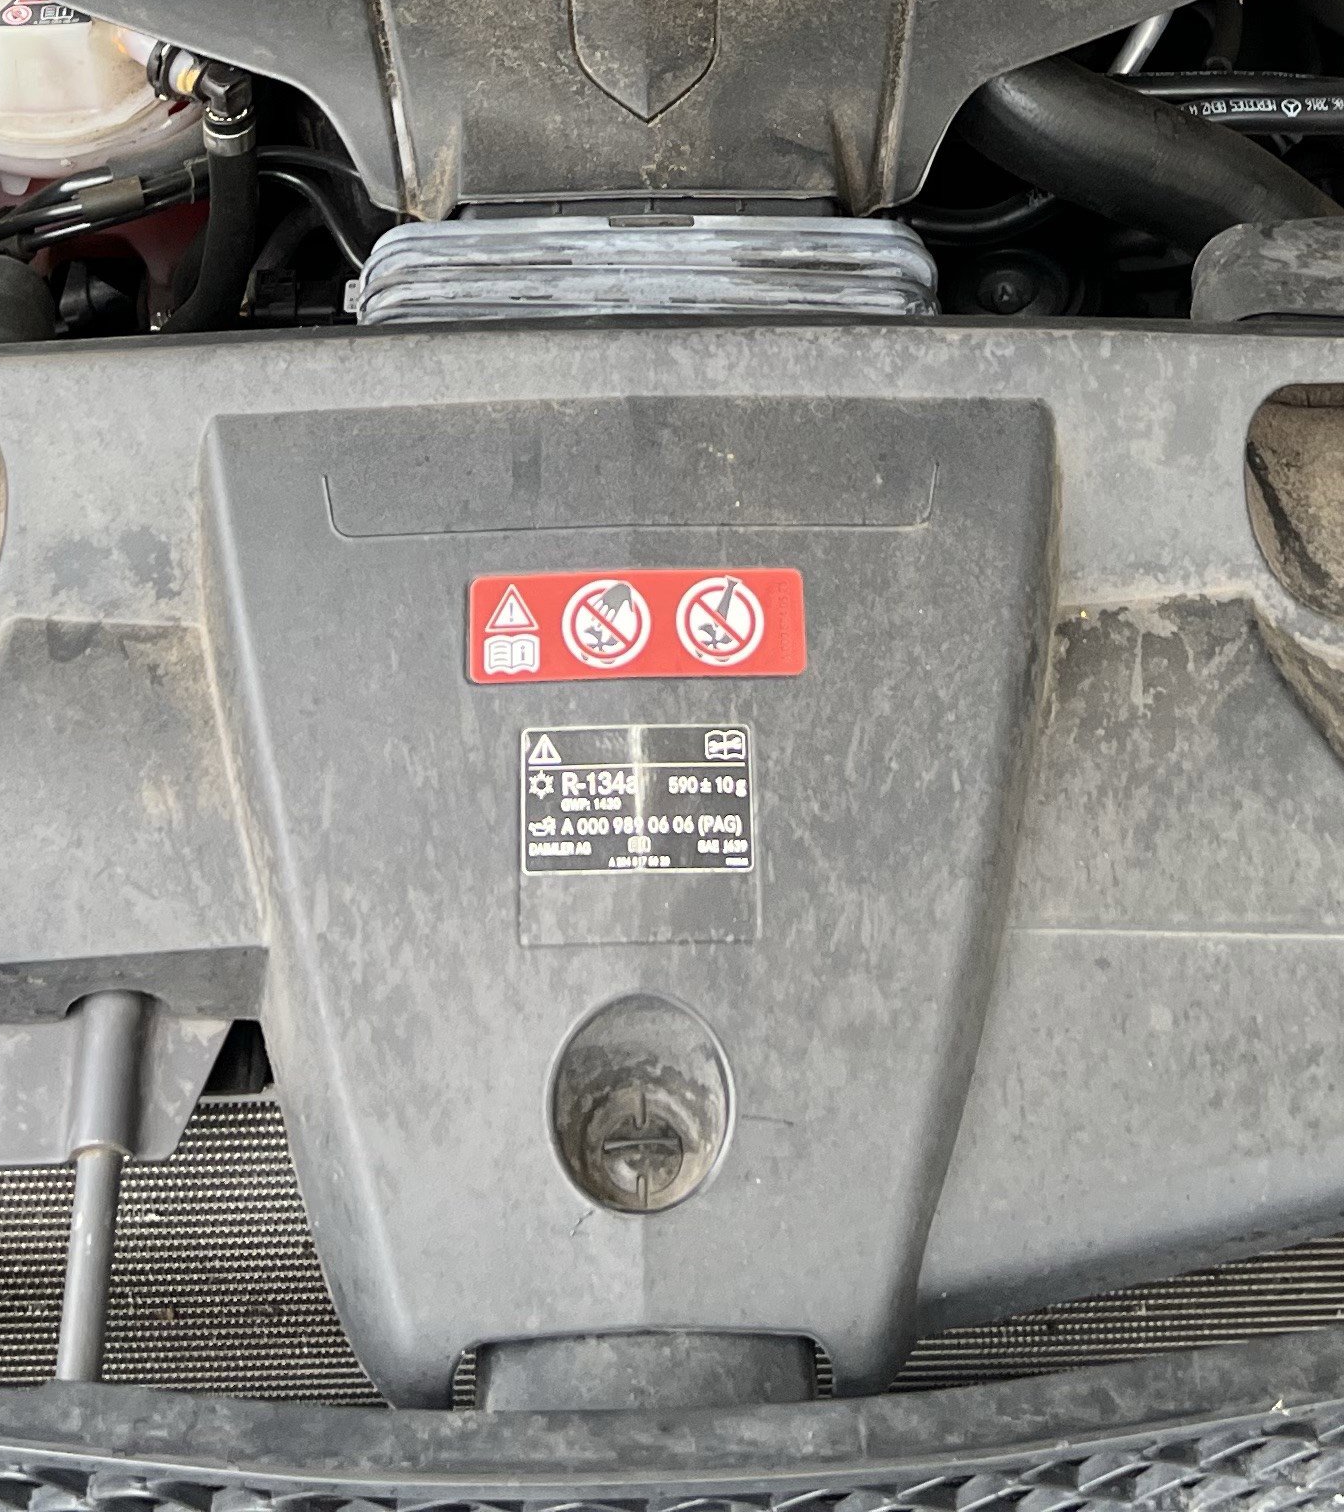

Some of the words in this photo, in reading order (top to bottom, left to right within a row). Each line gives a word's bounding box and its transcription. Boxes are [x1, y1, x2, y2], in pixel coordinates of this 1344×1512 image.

[561, 771, 638, 796] R-134a
[668, 776, 698, 794] 590
[561, 818, 574, 835] A
[577, 817, 609, 835] 000
[613, 816, 644, 835] 989
[647, 816, 670, 834] 06
[672, 815, 694, 834] 06
[697, 814, 743, 837] (PAG)
